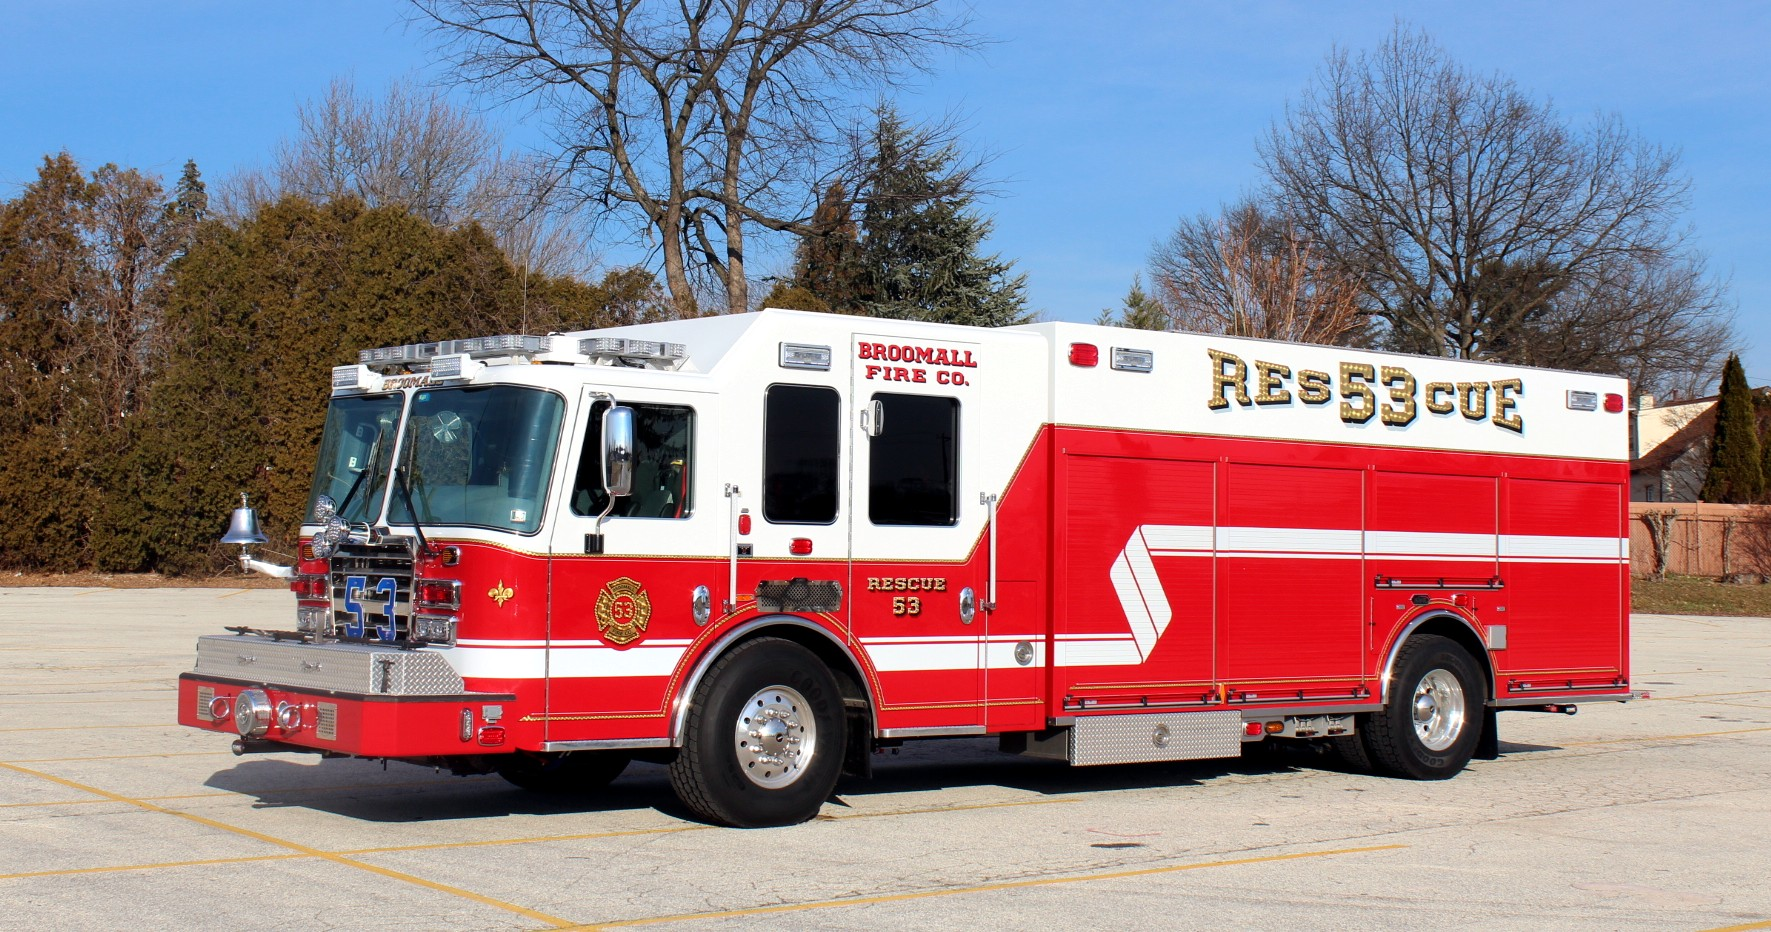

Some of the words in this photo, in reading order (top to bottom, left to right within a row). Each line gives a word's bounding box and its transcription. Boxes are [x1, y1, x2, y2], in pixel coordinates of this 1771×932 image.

[858, 341, 977, 368] BROOMALL
[865, 364, 927, 383] FIRE
[936, 370, 969, 386] CO.
[867, 577, 947, 591] RESCUE
[345, 576, 397, 641] 53
[615, 602, 633, 618] 53
[893, 596, 921, 615] 53
